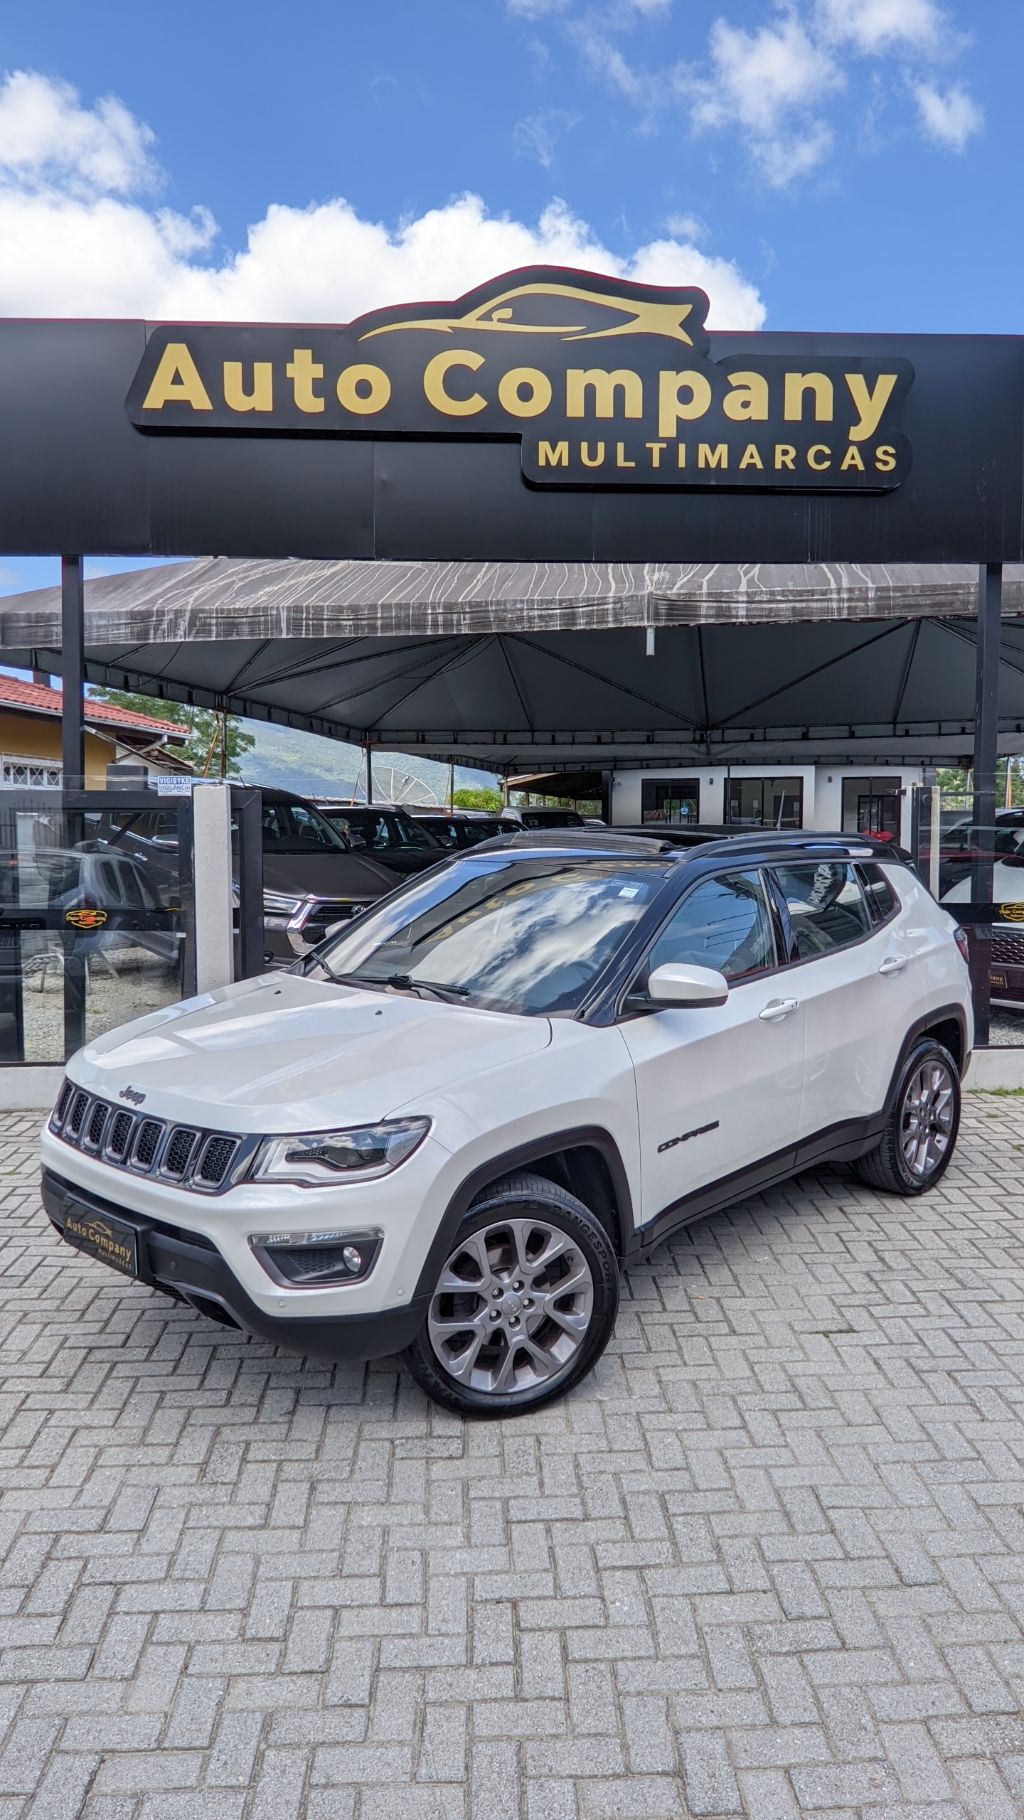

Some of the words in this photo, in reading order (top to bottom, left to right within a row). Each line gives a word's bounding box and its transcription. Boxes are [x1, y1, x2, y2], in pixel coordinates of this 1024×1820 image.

[142, 342, 391, 415] Auto
[423, 349, 899, 442] Company
[537, 440, 897, 472] MULTIMARCAS
[119, 1085, 147, 1106] Jeep
[66, 1216, 87, 1237] Auto
[88, 1228, 132, 1263] Company
